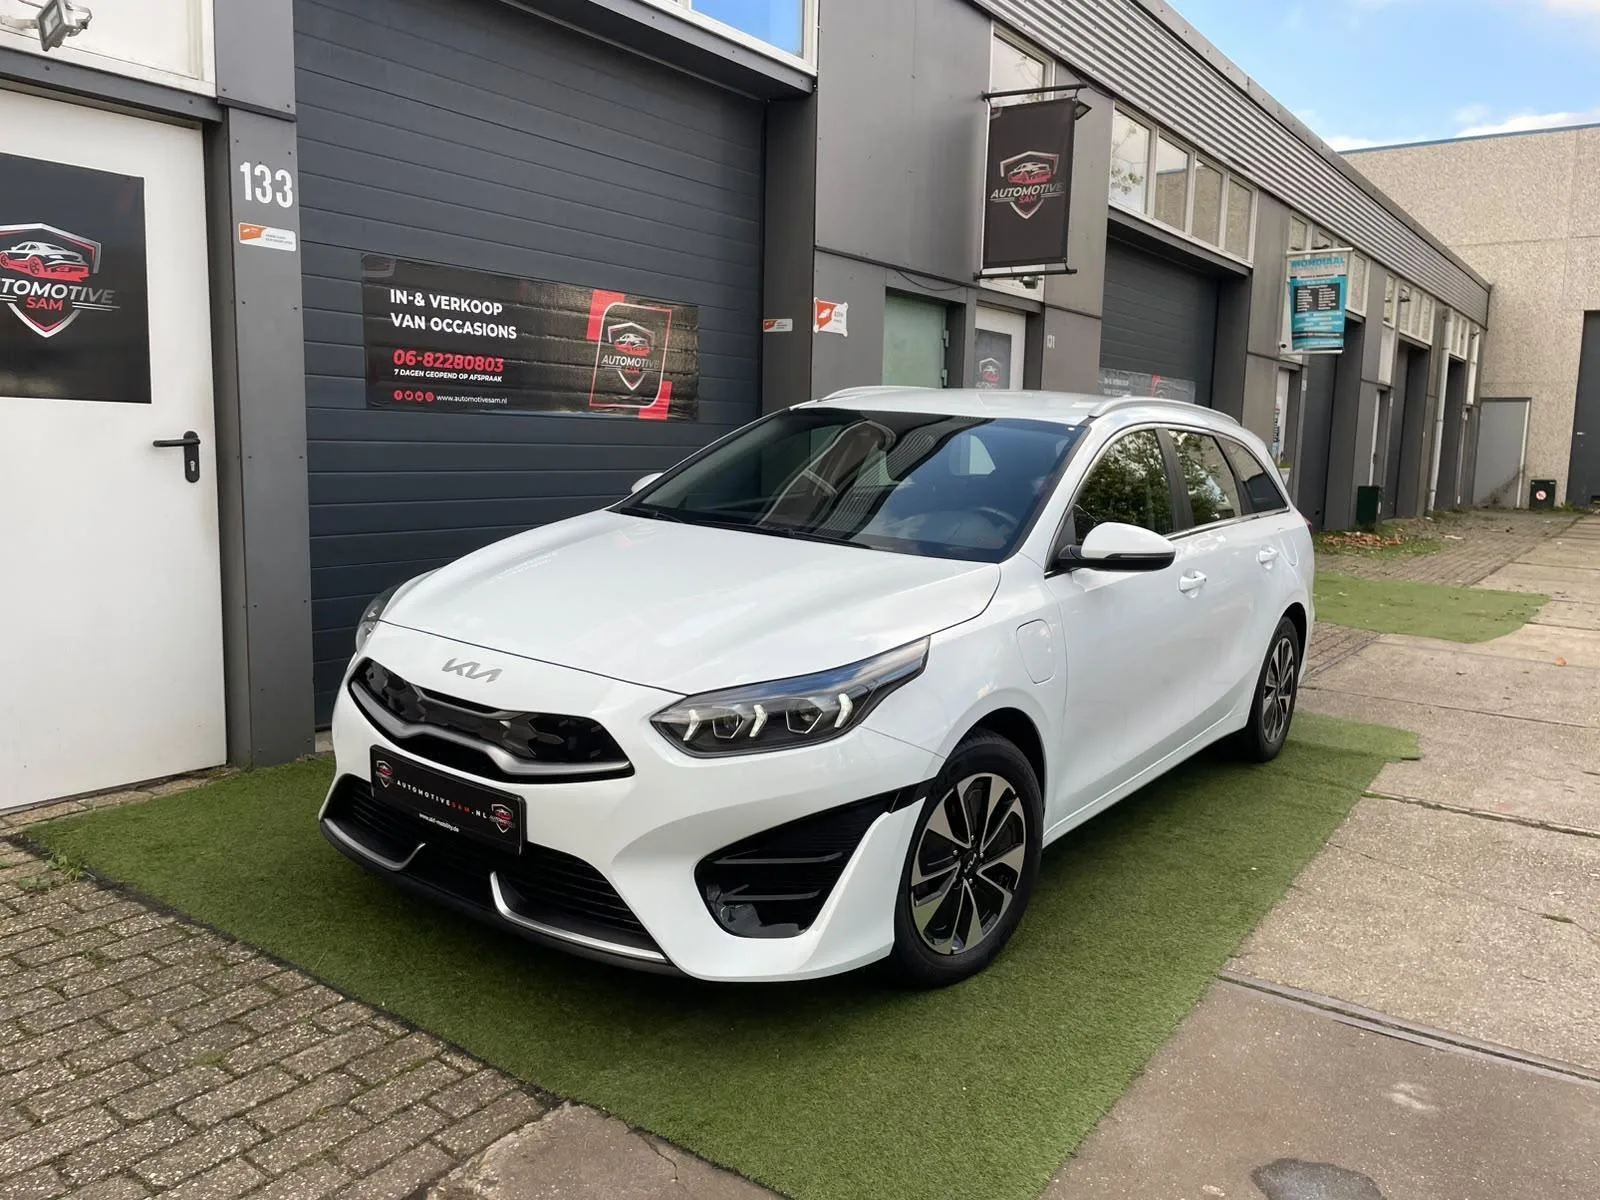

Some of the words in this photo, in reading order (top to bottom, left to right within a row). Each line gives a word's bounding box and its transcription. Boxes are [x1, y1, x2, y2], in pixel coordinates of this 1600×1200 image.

[240, 161, 293, 208] 133
[990, 182, 1064, 199] AUTOMOTIVE
[26, 296, 64, 311] SAM
[428, 293, 503, 316] VERKOOP
[390, 312, 426, 330] VAN
[429, 316, 518, 340] OCCASIONS
[393, 349, 505, 374] 06-82280803
[601, 354, 660, 369] AUTOMOTIVE
[394, 368, 399, 376] 7
[400, 369, 425, 378] DAGEN
[425, 370, 458, 380] GEOPEND
[458, 372, 469, 381] OP
[469, 374, 503, 383] AFSPRAAK
[436, 394, 508, 404] www.automotivesam.nl
